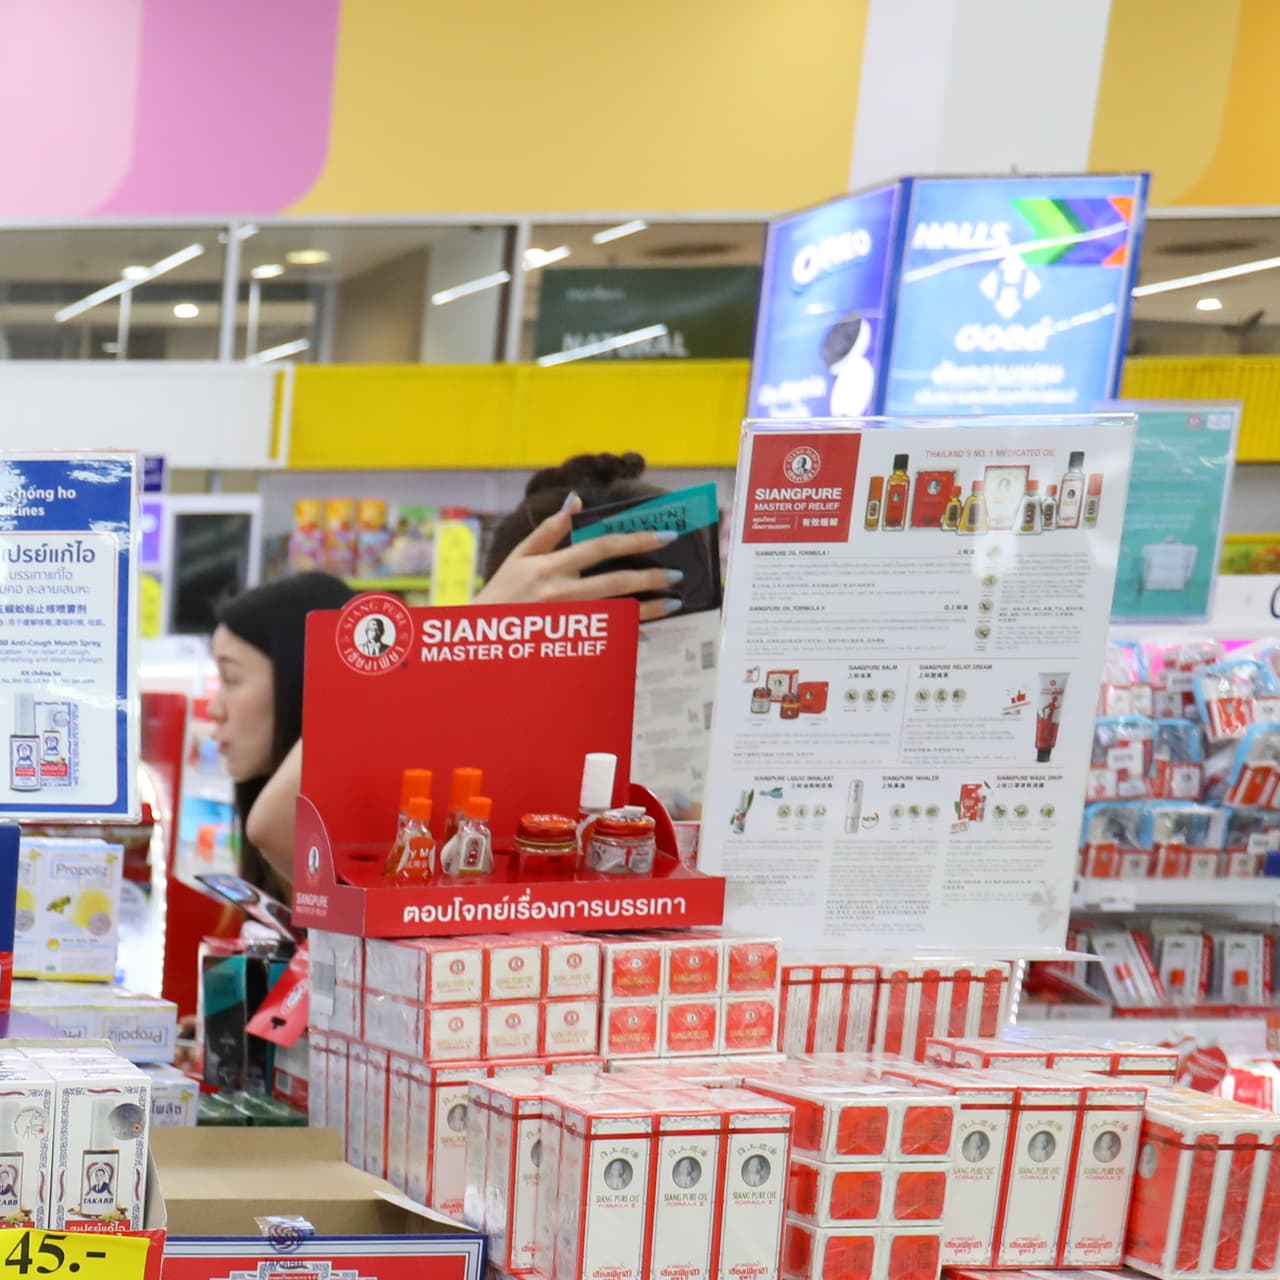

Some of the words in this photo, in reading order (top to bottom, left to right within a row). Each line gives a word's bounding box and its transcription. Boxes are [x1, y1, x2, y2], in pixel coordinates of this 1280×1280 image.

[913, 222, 1010, 250] HALLS
[57, 487, 76, 499] ho
[755, 487, 842, 500] SIANGPURE
[754, 502, 793, 512] MASTER
[795, 502, 808, 511] OF
[810, 501, 840, 511] RELIEF
[422, 614, 609, 643] SIANGPURE
[421, 644, 503, 662] MASTER
[508, 643, 535, 659] OF
[540, 641, 607, 657] RELIEF
[55, 861, 106, 882] Propoliz
[403, 890, 686, 923] ตอบโจทย์เรื่องการบรรเทา
[82, 1196, 118, 1206] TAKABB
